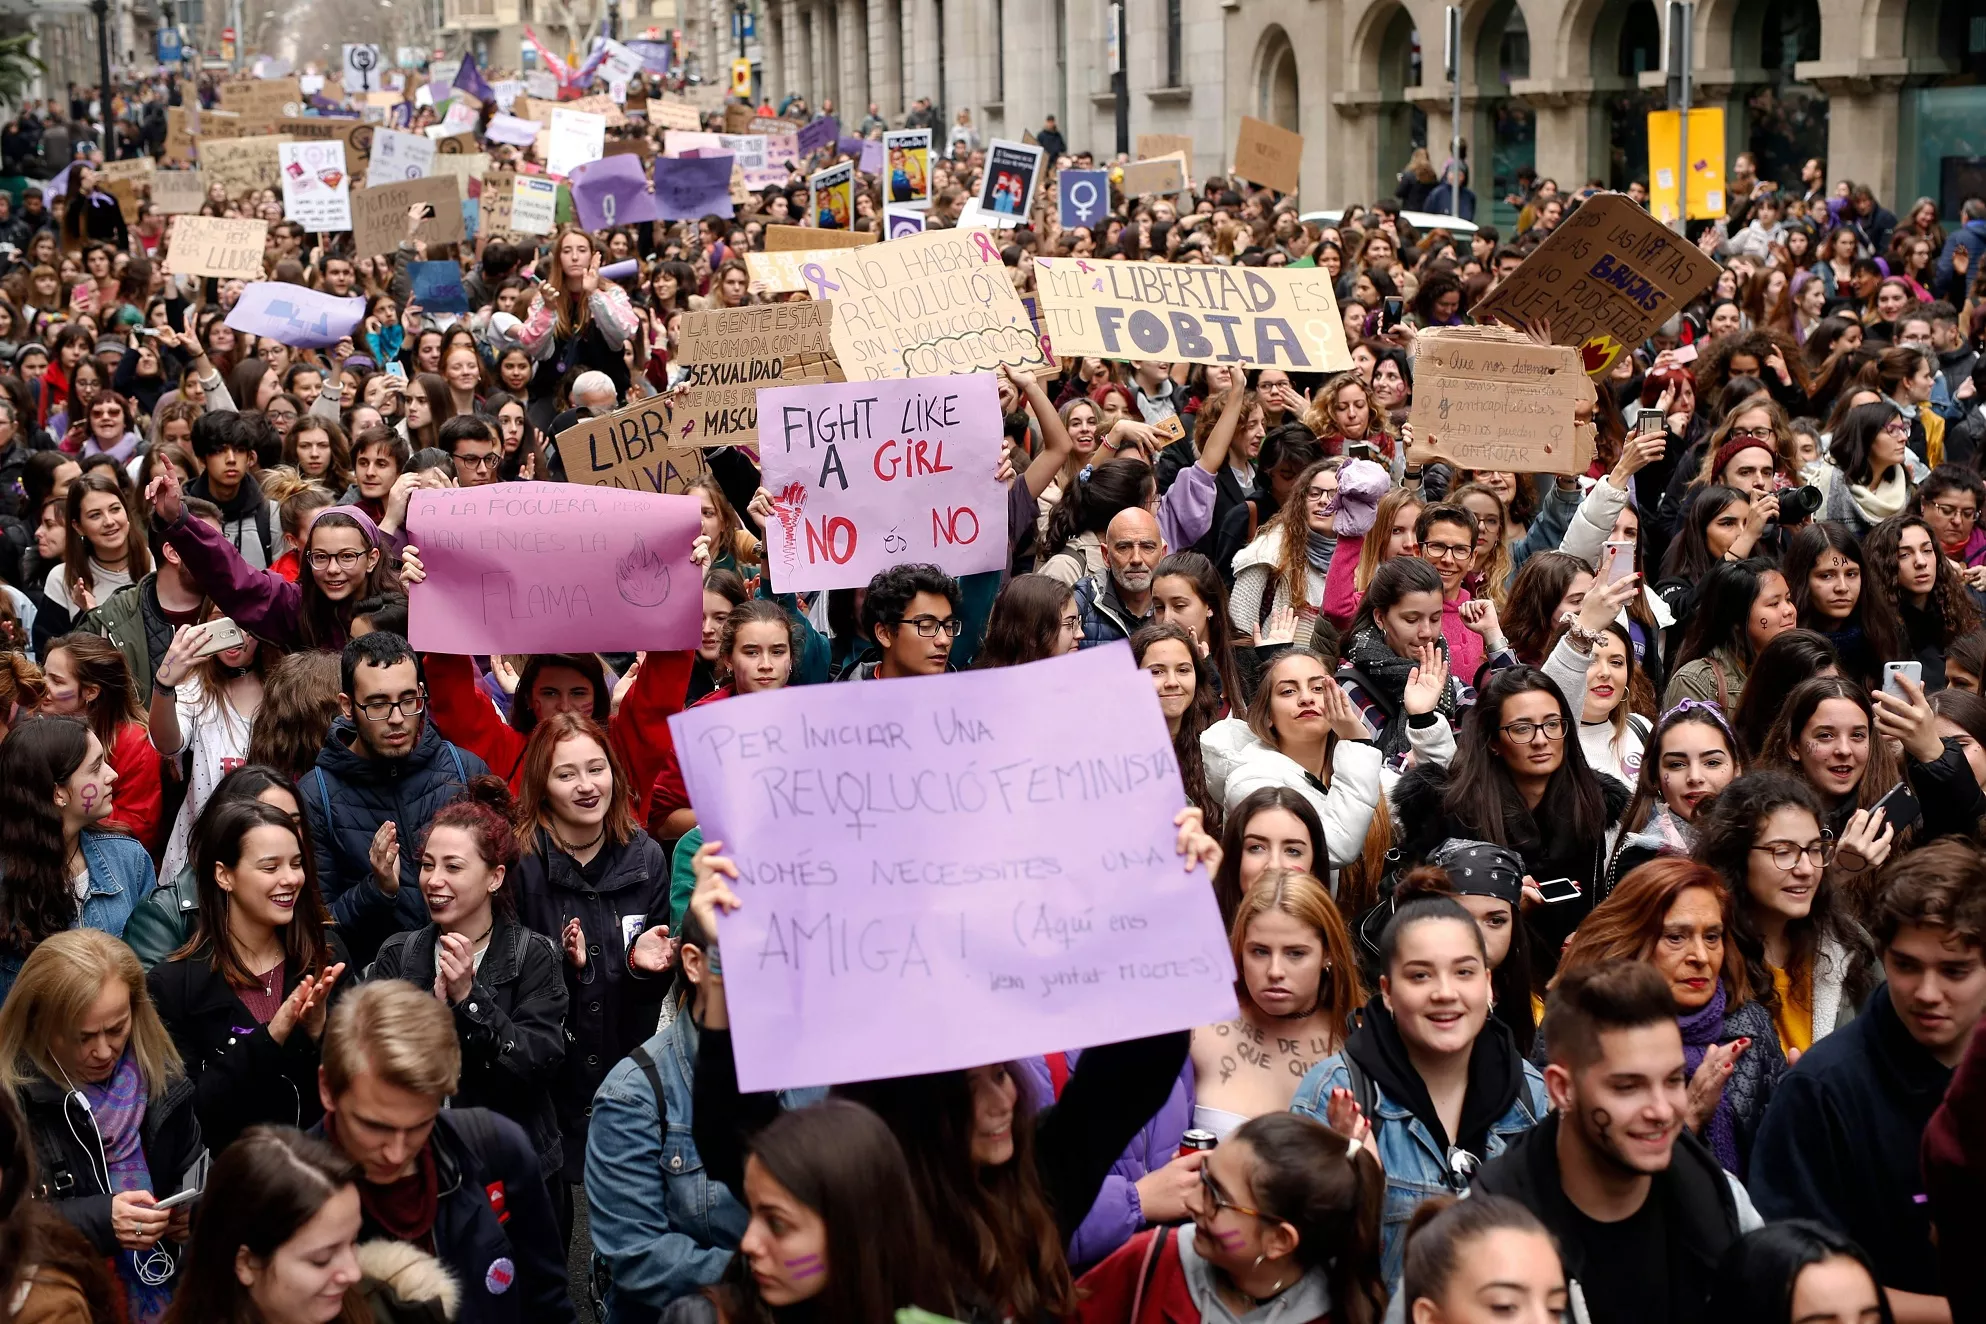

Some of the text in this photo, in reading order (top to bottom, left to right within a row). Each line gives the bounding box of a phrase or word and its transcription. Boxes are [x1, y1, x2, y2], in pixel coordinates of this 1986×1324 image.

[1606, 225, 1636, 248] LAS
[836, 260, 887, 297] NO
[899, 232, 988, 281] HABRÁ
[1538, 264, 1561, 283] NO
[1049, 265, 1330, 312] MI LIBERTAD ES
[1588, 253, 1667, 311] BRUJAS
[839, 267, 1013, 336] REVOLUCIÓN
[688, 304, 822, 337] LA GENTE ESTA
[853, 307, 1001, 361] SIN EVOLUCIÓN
[1044, 306, 1312, 366] TU FOBIA
[693, 331, 825, 361] INCOMODA CON LA
[865, 361, 890, 382] DE
[910, 332, 1032, 375] CONCIENCIAS
[1450, 349, 1476, 371] Que
[1481, 359, 1509, 372] nos
[679, 391, 702, 410] QUE
[705, 390, 722, 407] NO
[723, 389, 738, 406] ES
[1436, 377, 1565, 399] que somos feministas
[704, 406, 758, 437] MASCU
[783, 397, 878, 453] FIGHT
[1455, 398, 1556, 419] anticapitalistas
[589, 409, 672, 472] LIBR
[1498, 427, 1537, 442] pueden
[819, 443, 849, 490] A
[1451, 443, 1531, 464] CONTROLAR
[420, 504, 436, 516] A
[451, 503, 477, 516] LA
[423, 529, 464, 550] HAN
[579, 531, 607, 553] LA
[805, 506, 979, 564] NO és NO
[1832, 556, 1849, 567] 8M
[481, 570, 594, 626] FLAMA
[697, 706, 996, 766] PER INICIAR UNA
[752, 746, 1178, 842] REVOLUCIÓ FEMINISTA
[872, 856, 1063, 886] NECESSITES
[1102, 847, 1164, 873] UNA
[1012, 900, 1096, 949] (Aquí
[1109, 913, 1148, 932] ens
[1039, 965, 1108, 998] juntat
[1236, 1041, 1273, 1070] QUE
[1277, 1037, 1301, 1058] DE
